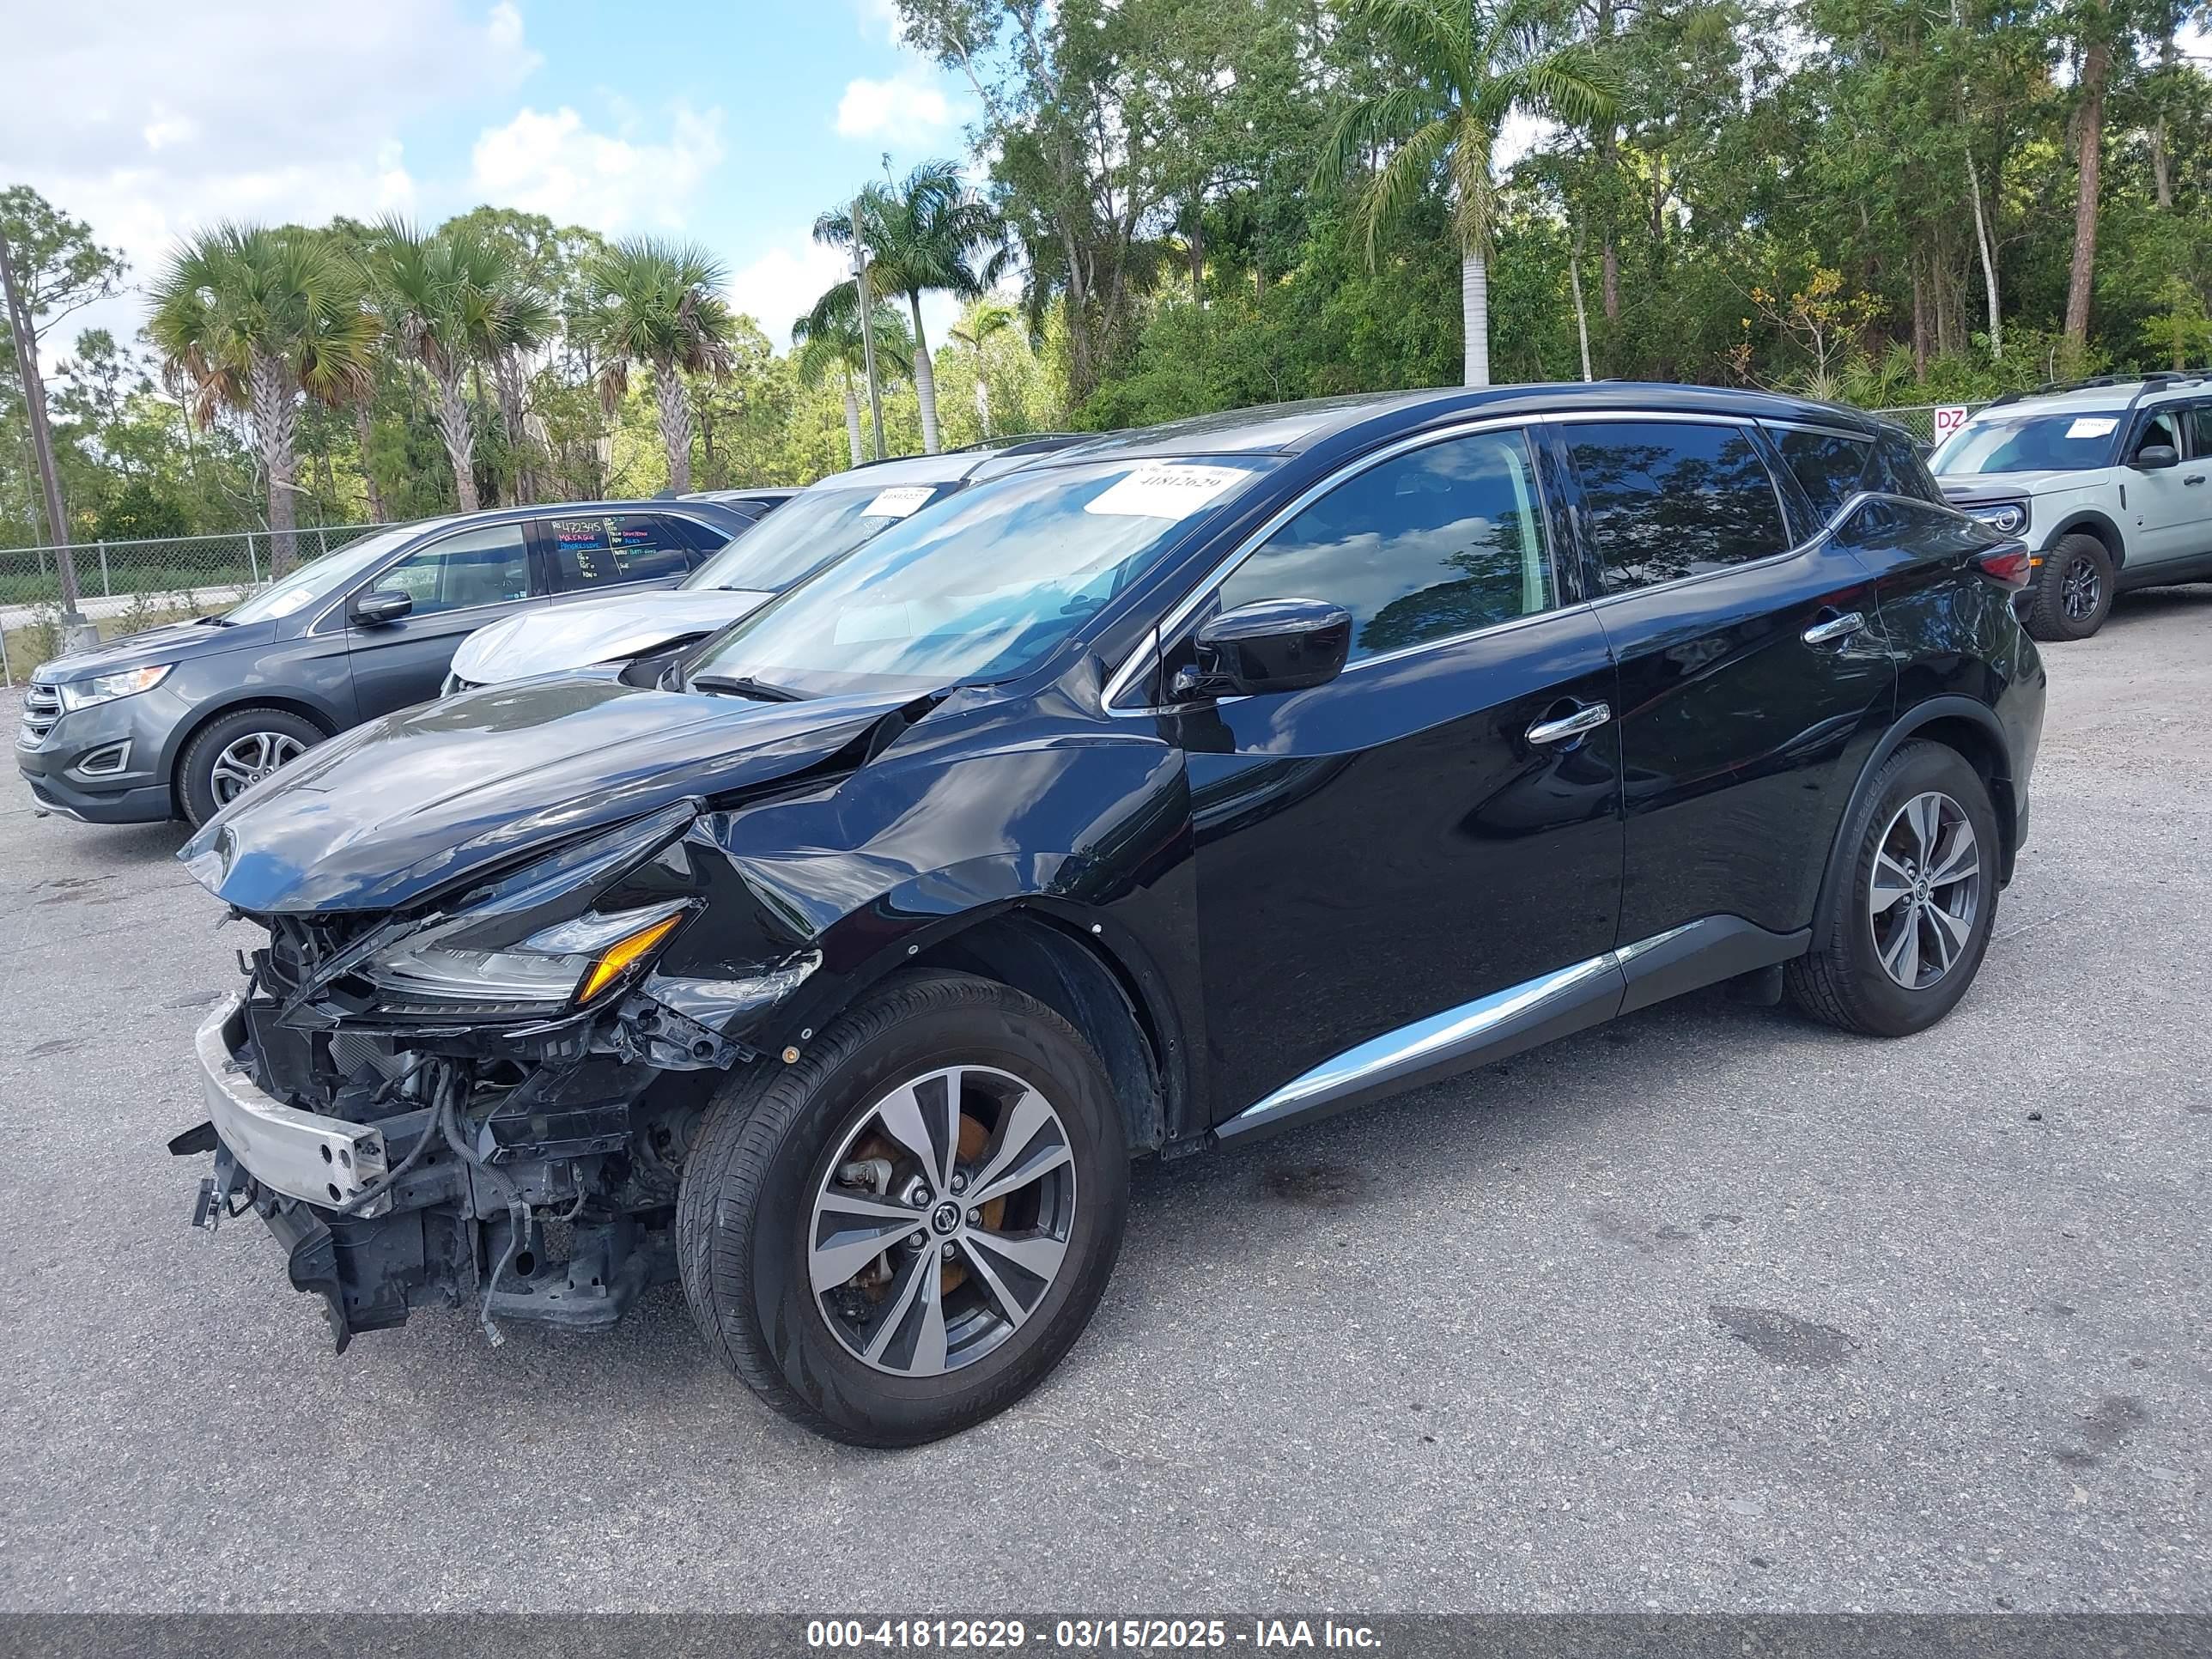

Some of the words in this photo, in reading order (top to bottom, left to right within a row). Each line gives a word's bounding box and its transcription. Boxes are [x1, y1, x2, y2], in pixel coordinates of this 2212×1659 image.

[1938, 410, 1964, 428] DZ
[1139, 476, 1222, 488] 41812629
[562, 520, 602, 534] 472345
[560, 542, 600, 550] PROGRESSIVE
